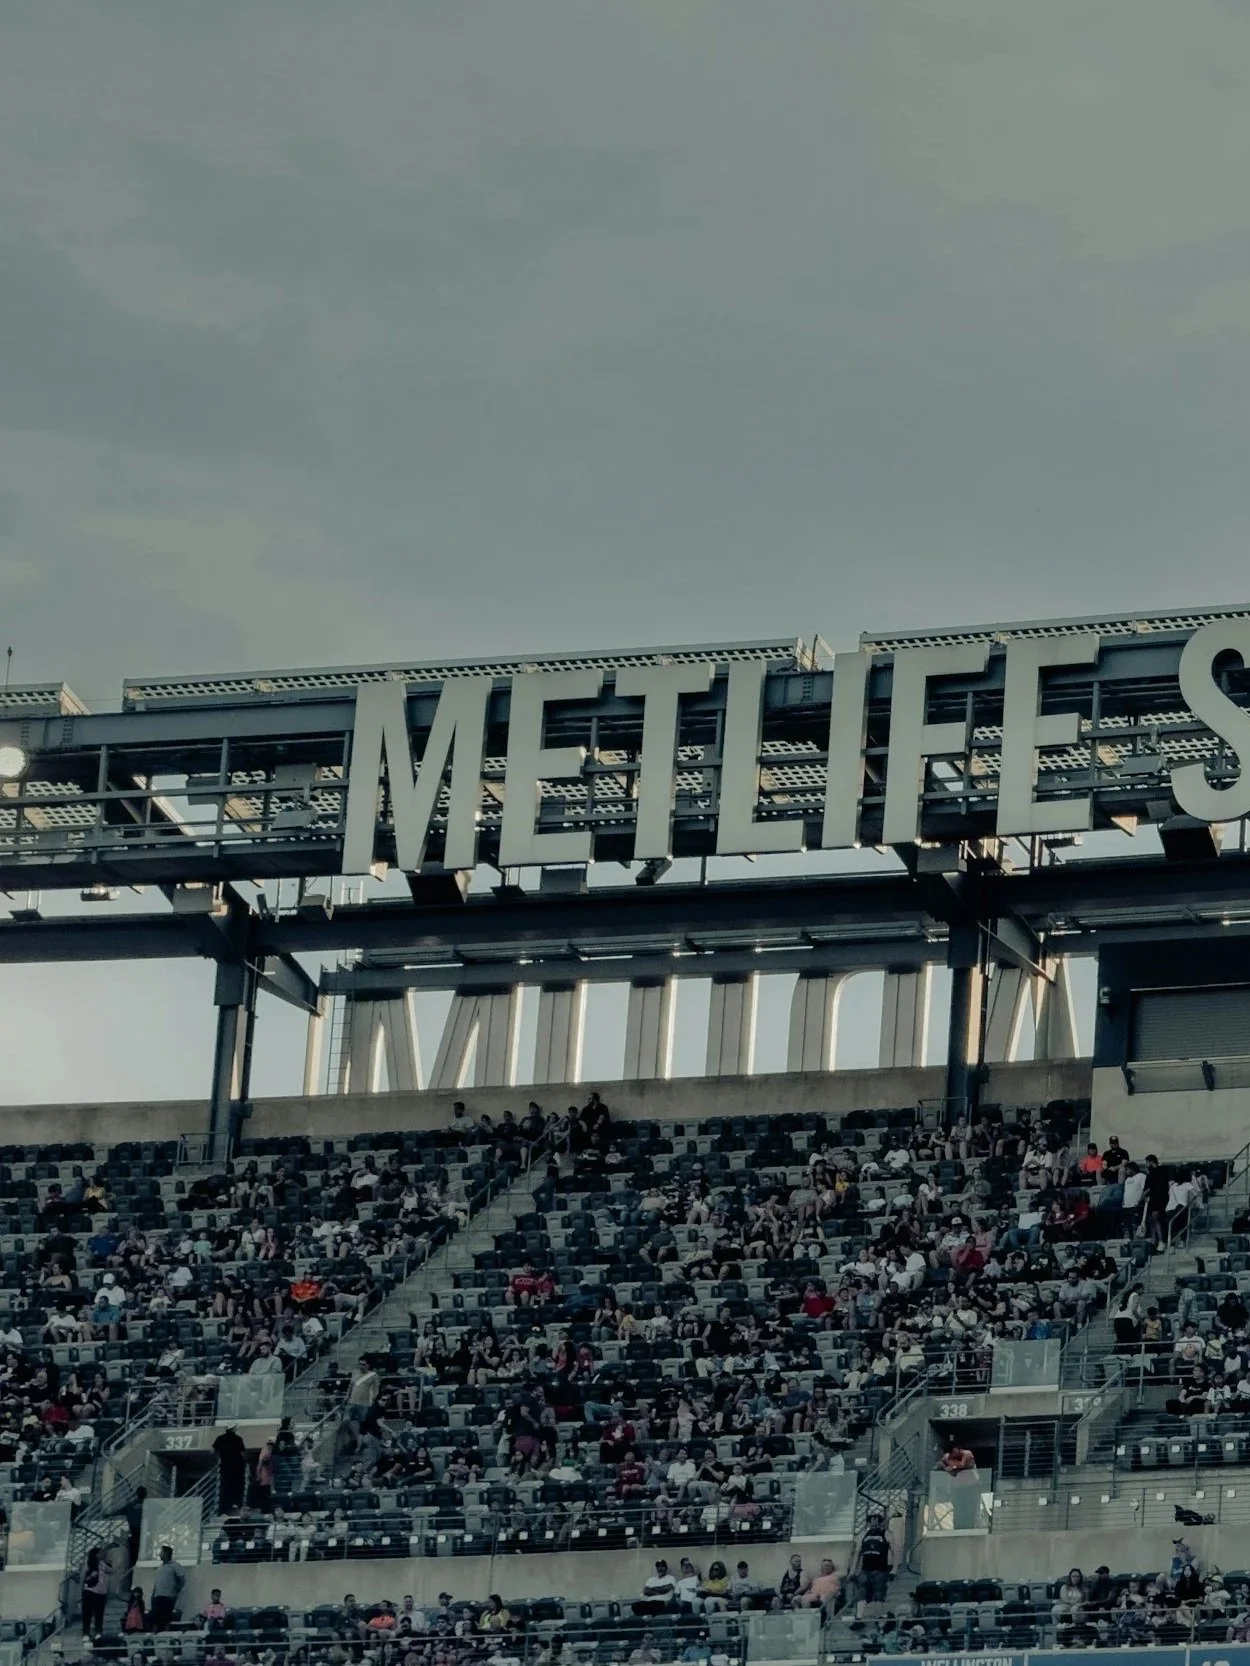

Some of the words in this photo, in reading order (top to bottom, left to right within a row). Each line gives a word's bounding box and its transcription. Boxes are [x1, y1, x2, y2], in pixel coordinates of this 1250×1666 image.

[342, 634, 1100, 875] METLIFE
[940, 1403, 968, 1418] 338
[165, 1435, 193, 1450] 337
